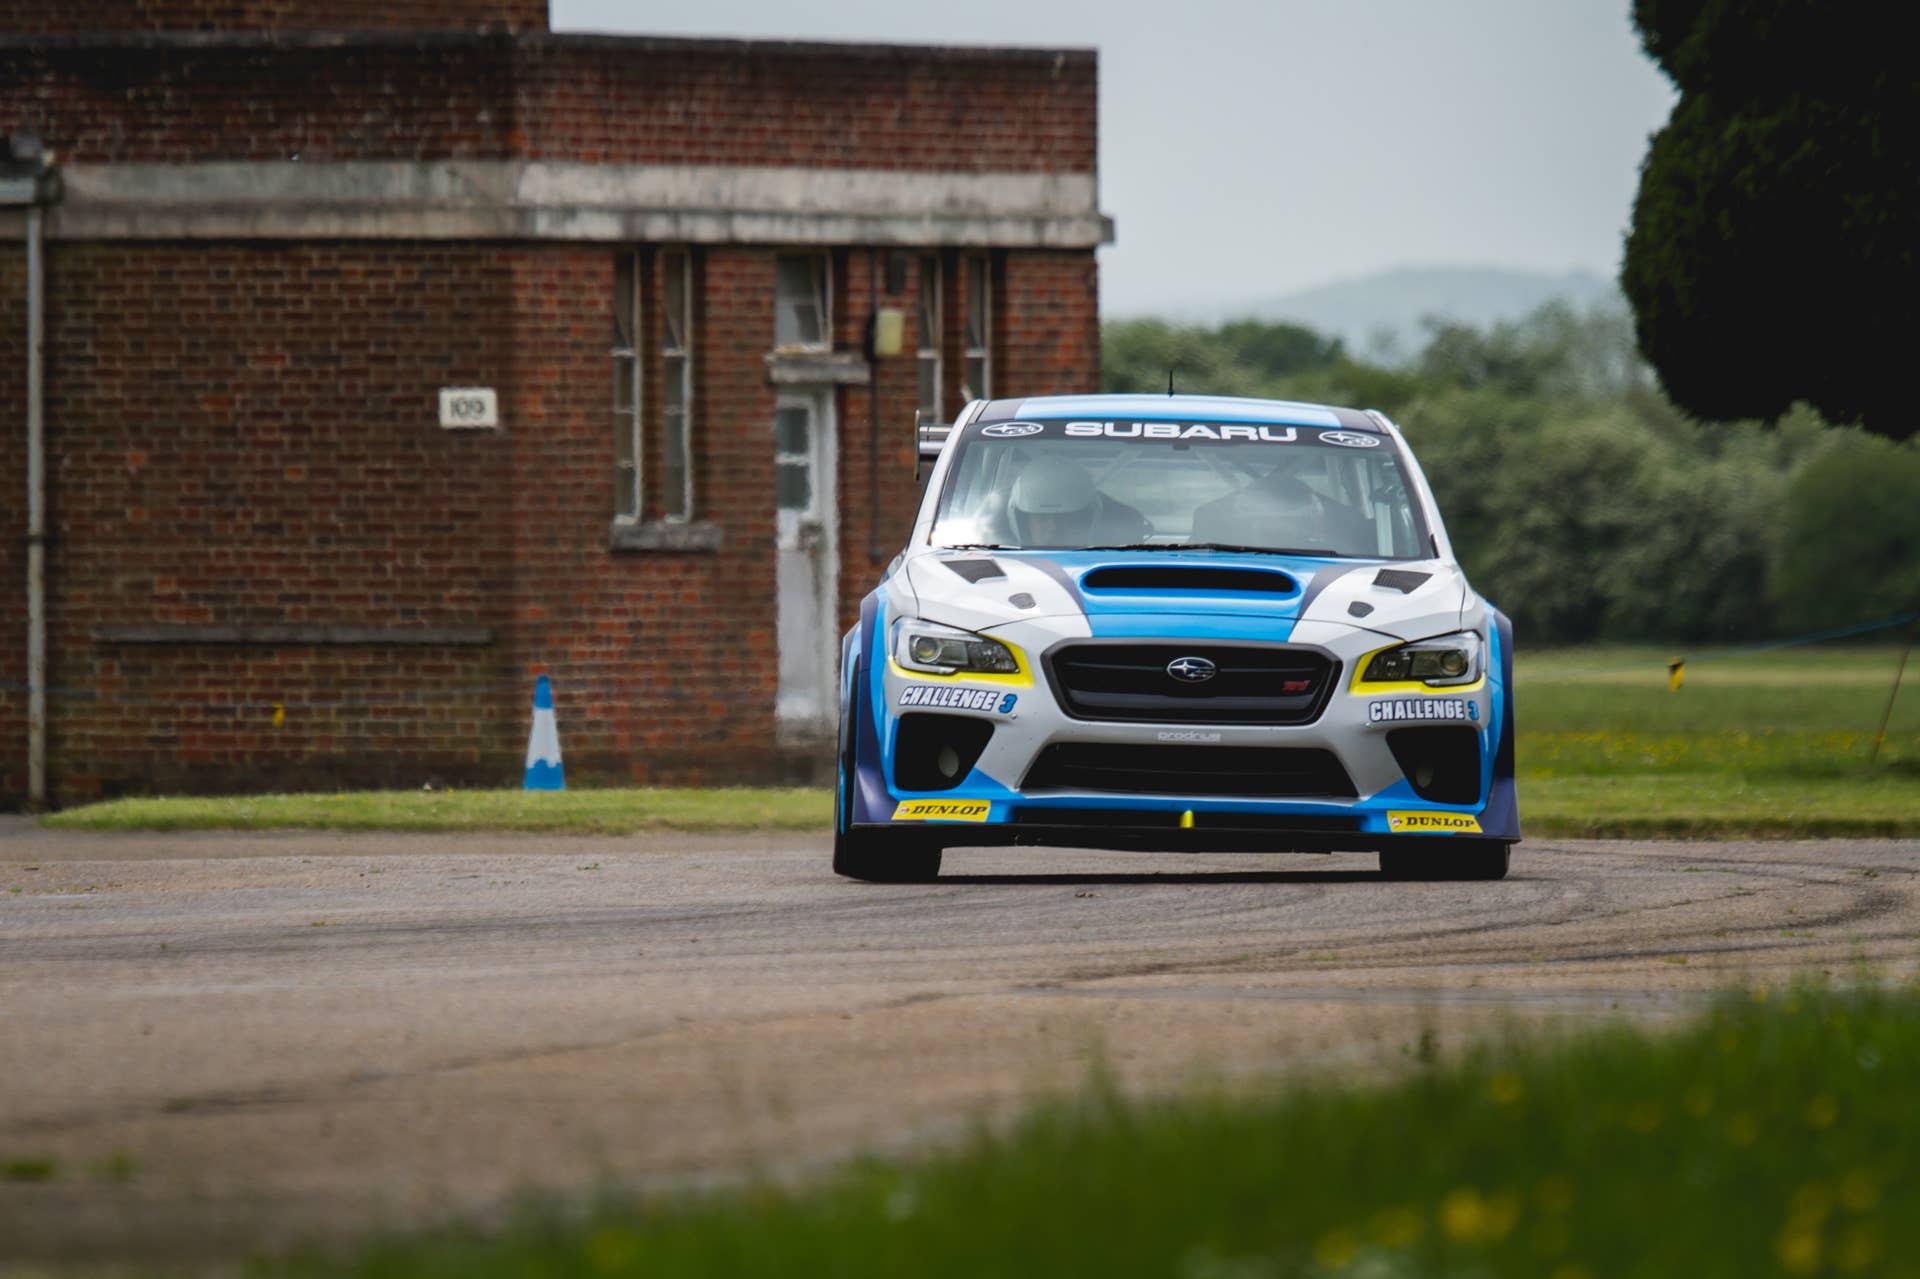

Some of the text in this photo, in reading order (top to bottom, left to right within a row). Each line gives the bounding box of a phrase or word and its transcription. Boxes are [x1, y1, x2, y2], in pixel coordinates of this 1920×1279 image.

[450, 398, 486, 420] 109
[1065, 422, 1297, 442] SUBARU
[899, 685, 1018, 714] CHALLENGE 3
[1369, 699, 1479, 722] CHALLENGE 3
[910, 805, 988, 816] DUNLOP
[1405, 816, 1475, 828] DUNLOP
